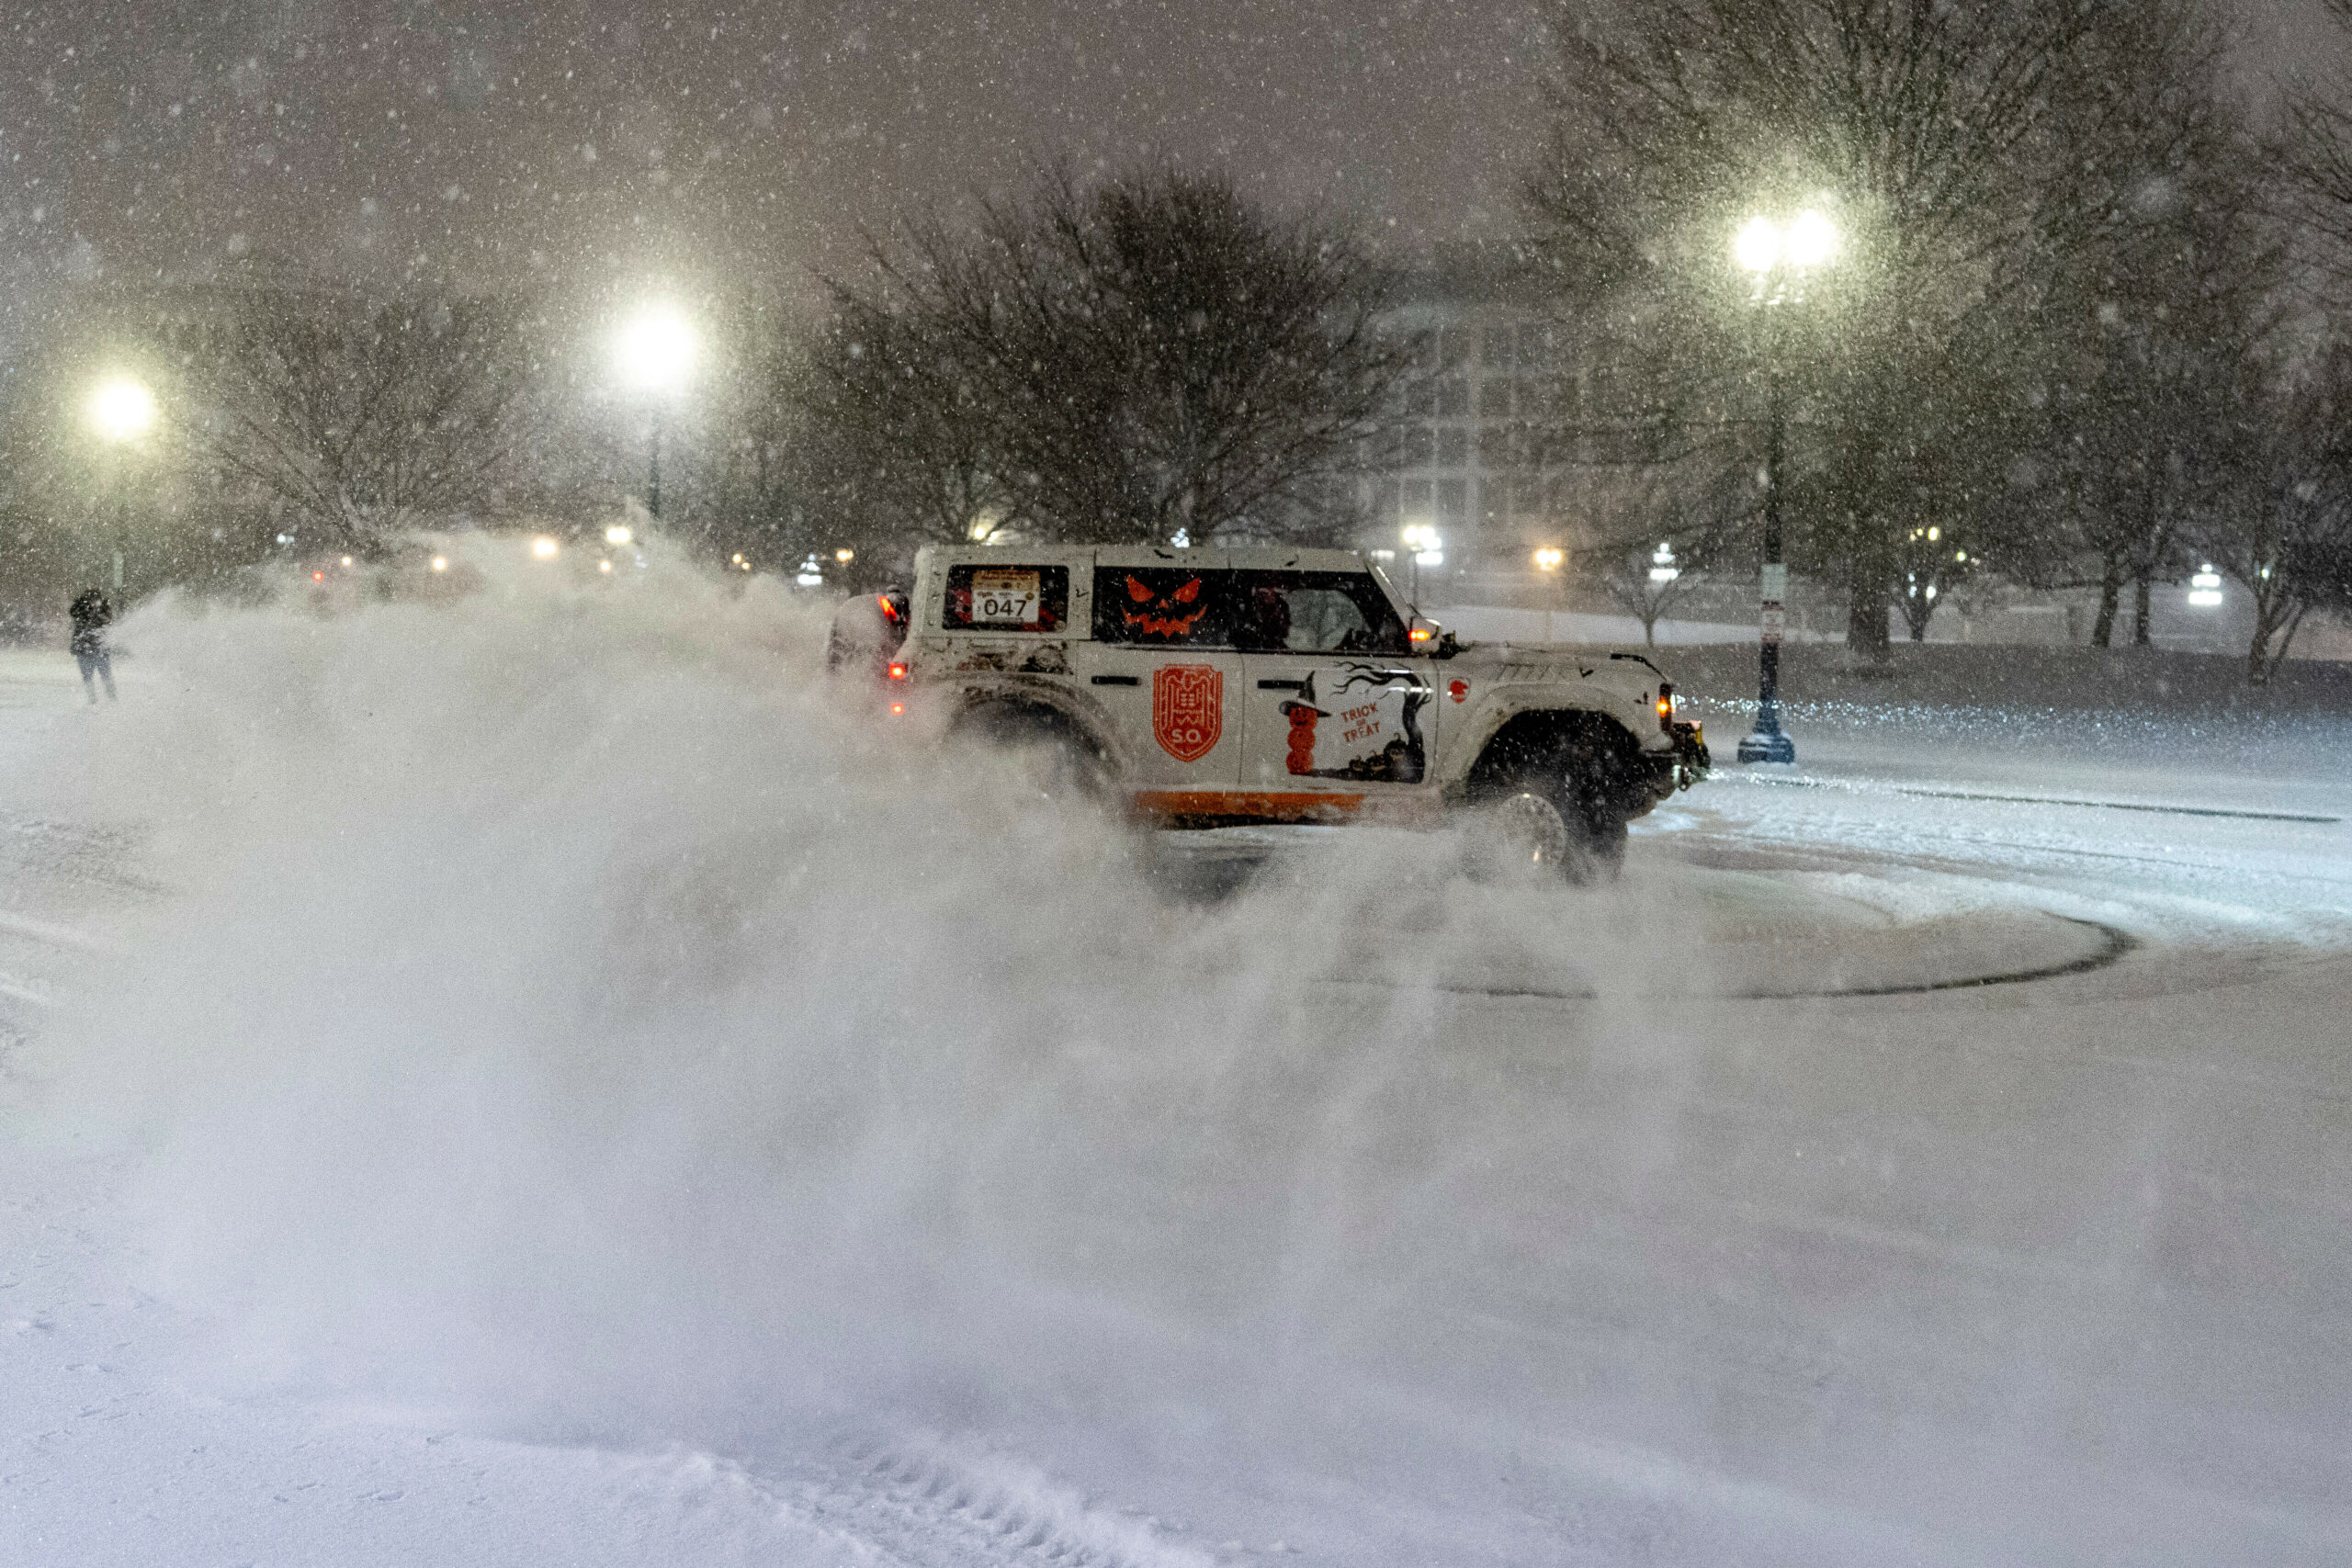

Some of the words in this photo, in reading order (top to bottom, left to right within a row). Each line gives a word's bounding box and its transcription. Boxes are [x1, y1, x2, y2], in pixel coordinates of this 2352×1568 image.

[984, 599, 1027, 616] 047
[1341, 702, 1378, 722] TRICK
[1343, 720, 1380, 742] TREAT
